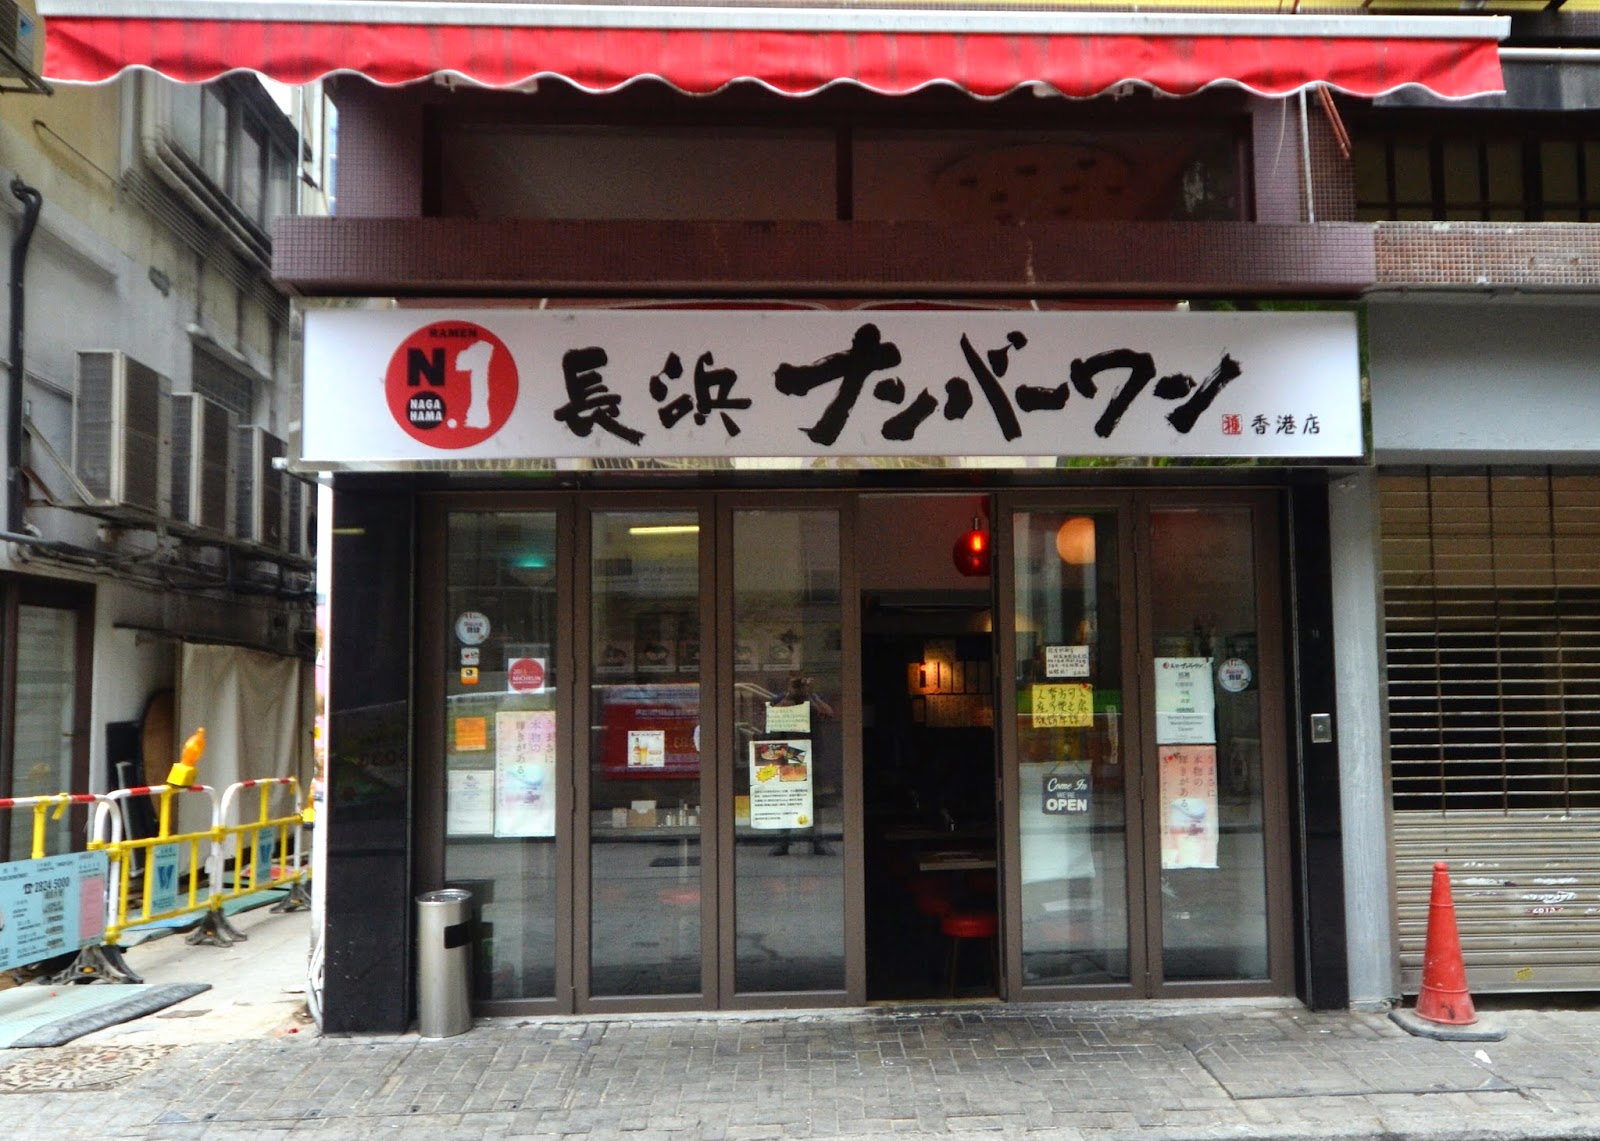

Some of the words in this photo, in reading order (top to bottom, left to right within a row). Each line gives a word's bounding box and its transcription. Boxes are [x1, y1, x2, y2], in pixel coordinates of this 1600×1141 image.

[429, 328, 479, 338] RAMEN
[410, 399, 442, 409] NAGA
[410, 410, 443, 421] HAMA
[1250, 413, 1320, 435] 香港店
[1047, 777, 1073, 792] Come
[1074, 778, 1088, 791] In
[1046, 798, 1088, 811] OPEN
[35, 880, 51, 892] 2824
[54, 877, 70, 889] 5000
